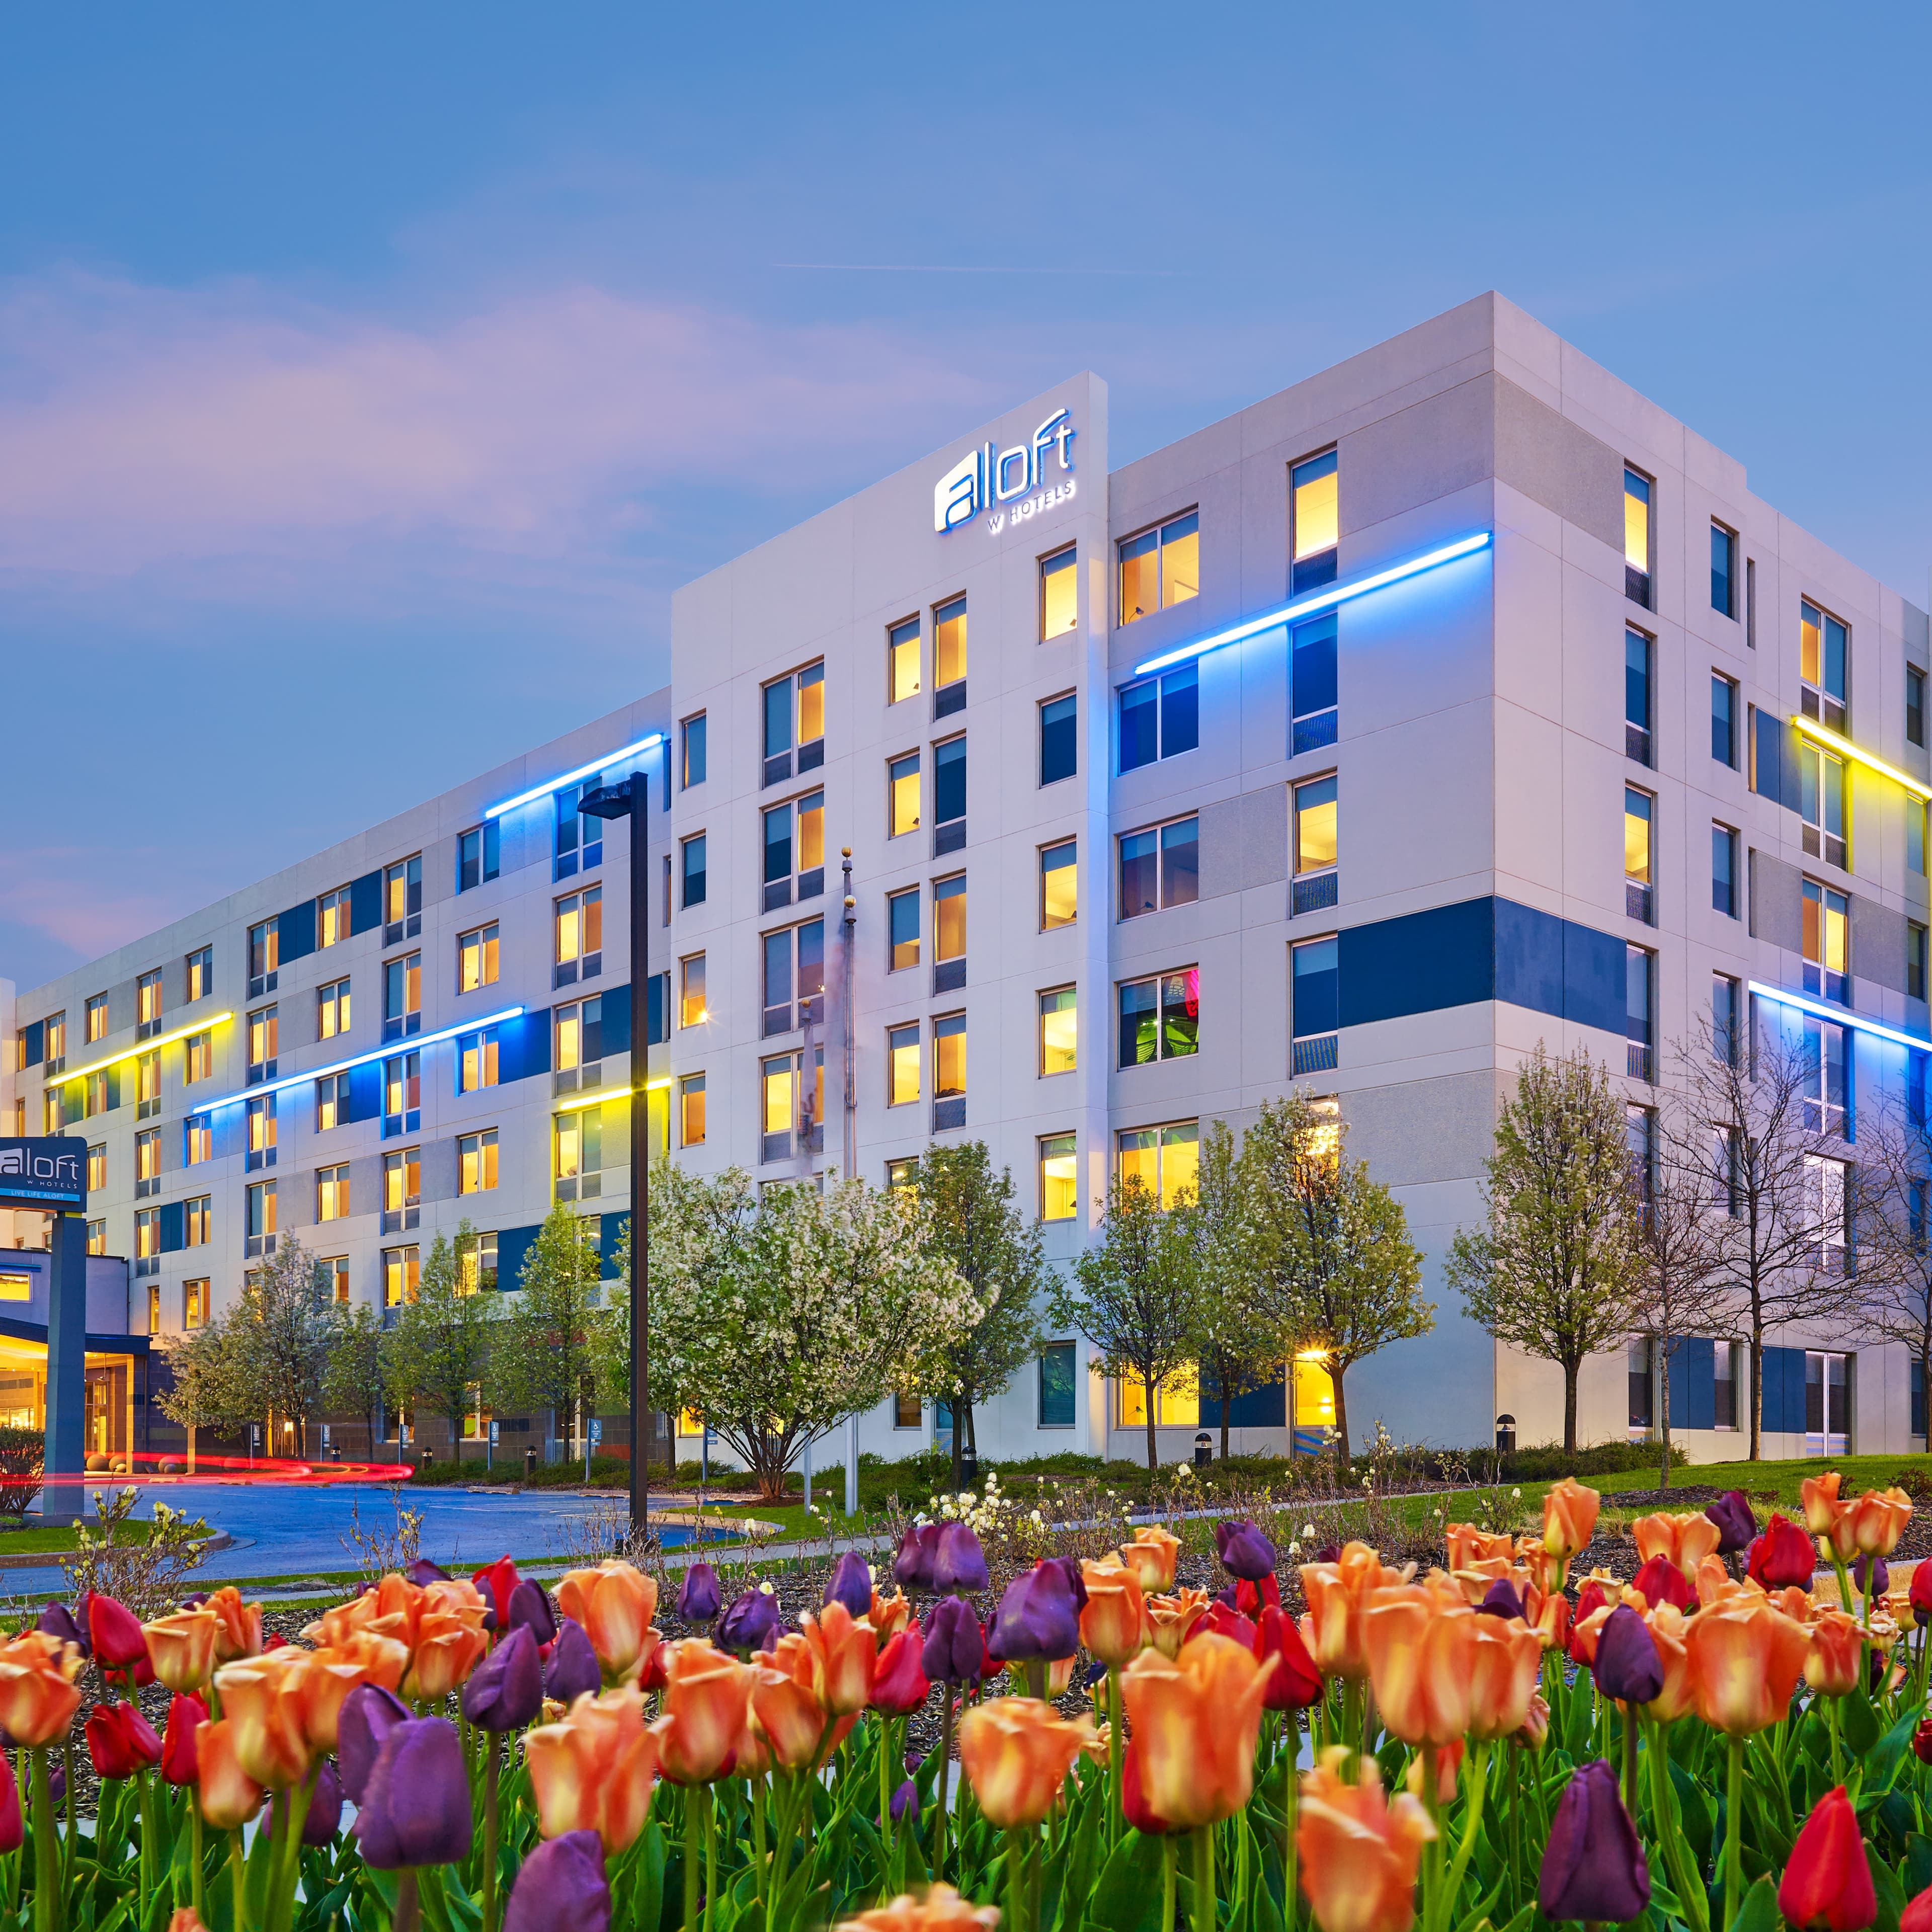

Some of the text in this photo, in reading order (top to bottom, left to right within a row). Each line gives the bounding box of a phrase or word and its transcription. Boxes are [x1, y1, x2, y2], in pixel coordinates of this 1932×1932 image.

[934, 408, 1075, 533] aloft
[988, 480, 1073, 532] W HOTELS
[0, 1148, 79, 1180] aloft
